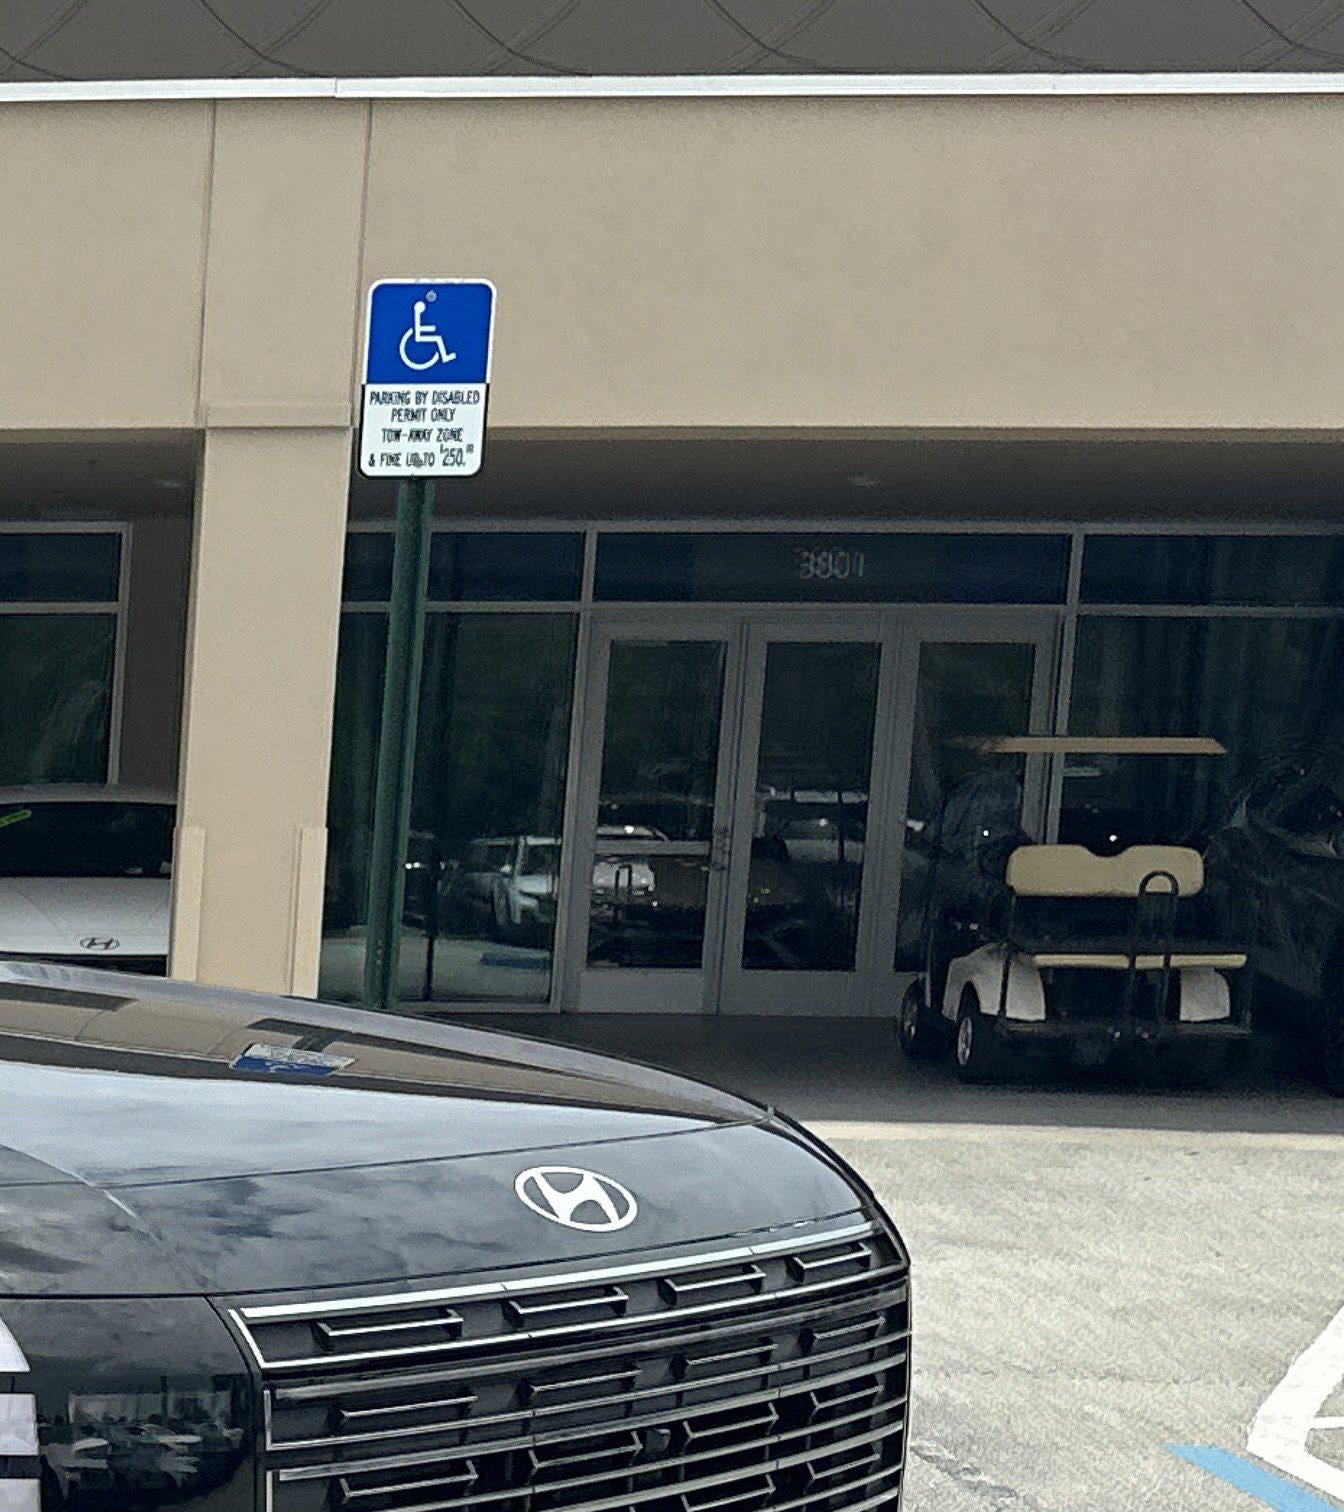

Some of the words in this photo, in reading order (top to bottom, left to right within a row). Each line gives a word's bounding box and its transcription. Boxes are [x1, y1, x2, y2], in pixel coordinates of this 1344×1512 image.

[369, 390, 411, 406] PARKING
[415, 390, 429, 406] BY
[432, 389, 480, 406] DISABLED
[390, 407, 428, 422] PERMIT
[430, 407, 457, 422] ONLY
[382, 427, 434, 443] TOW-AWAY
[436, 427, 464, 443] ZONE
[368, 453, 376, 468] &
[380, 452, 402, 468] FINE
[423, 452, 436, 468] TO
